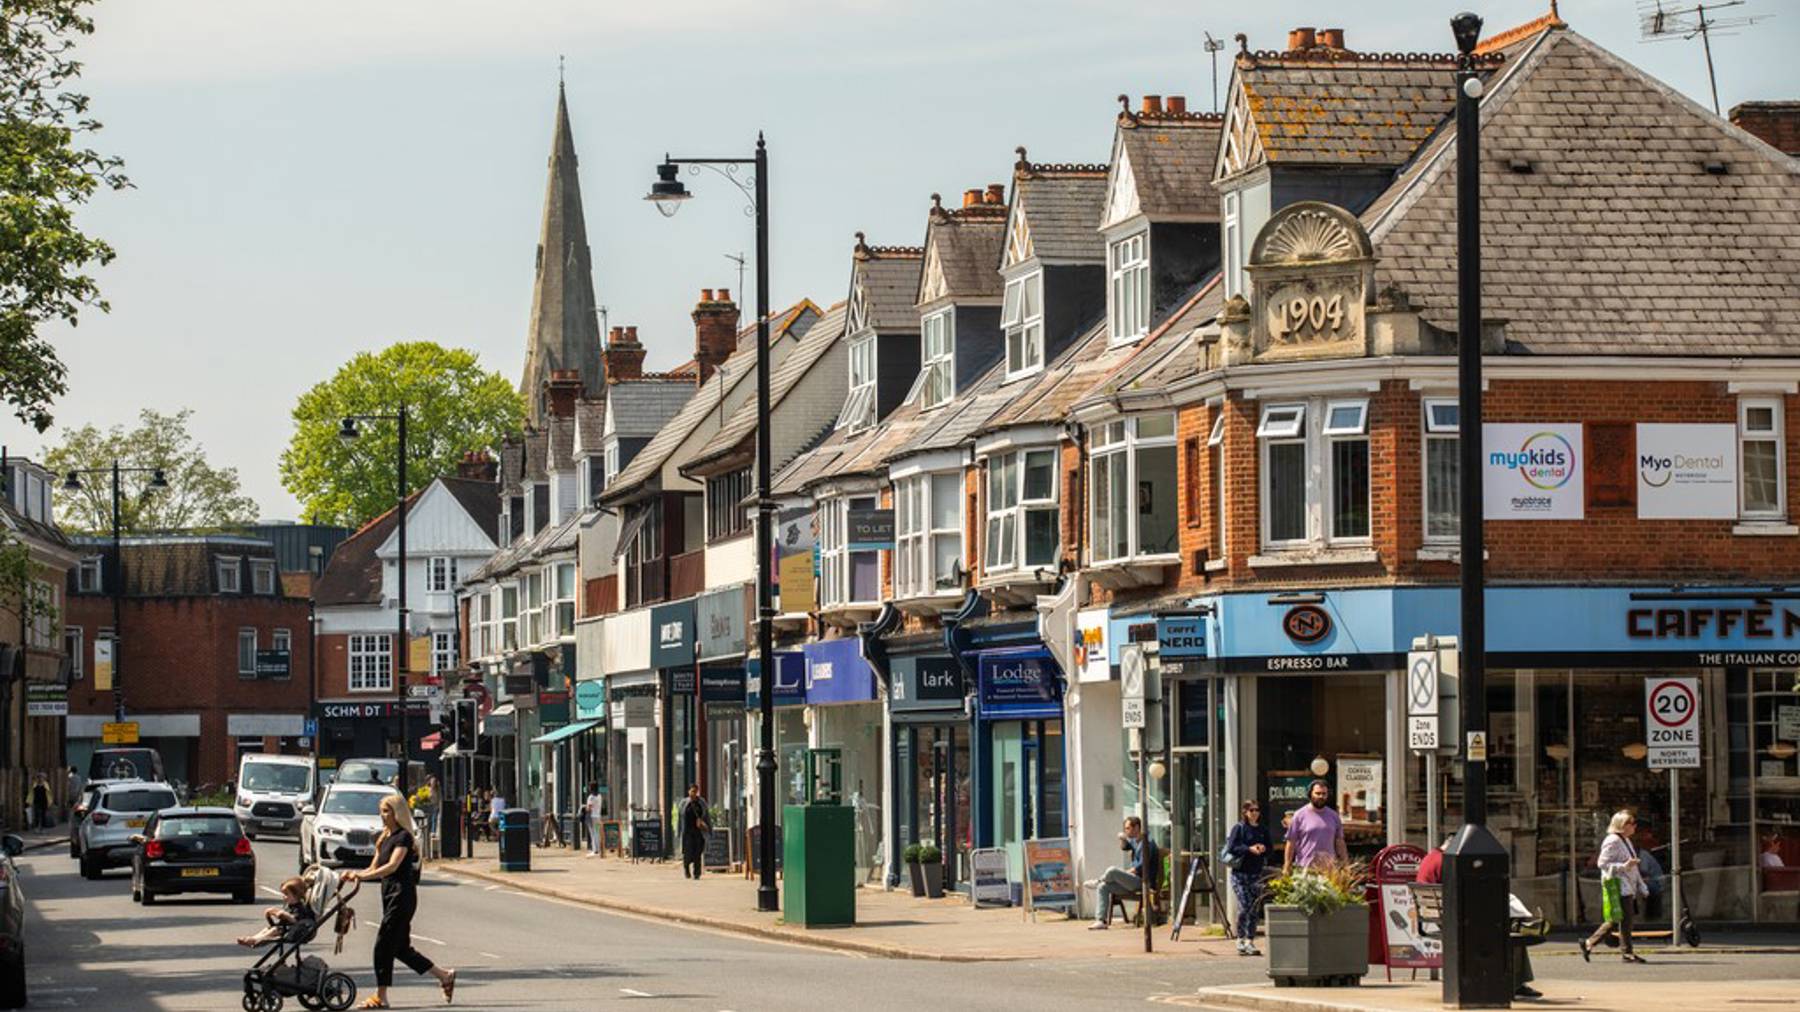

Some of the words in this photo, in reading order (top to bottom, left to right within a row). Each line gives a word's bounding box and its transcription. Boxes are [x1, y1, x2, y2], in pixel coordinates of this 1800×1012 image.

[1279, 294, 1344, 332] 1904
[1490, 449, 1565, 469] myokids
[1641, 455, 1672, 472] Myo
[1674, 454, 1724, 469] Dental
[1529, 467, 1565, 478] dental
[856, 525, 870, 533] TO
[872, 525, 891, 533] LET
[1628, 597, 1773, 638] CAFFÈ
[1160, 636, 1205, 649] NERO
[1267, 657, 1323, 670] ESPRESSO
[1326, 656, 1349, 668] BAR
[1700, 653, 1722, 665] THE
[1725, 653, 1775, 665] ITALIAN
[923, 669, 954, 688] lark
[992, 663, 1041, 684] Lodge
[1657, 694, 1689, 714] 20
[1415, 719, 1431, 730] Zone
[1412, 732, 1435, 746] ENDS
[1651, 729, 1694, 742] ZONE
[1383, 852, 1423, 869] TIMPSO
